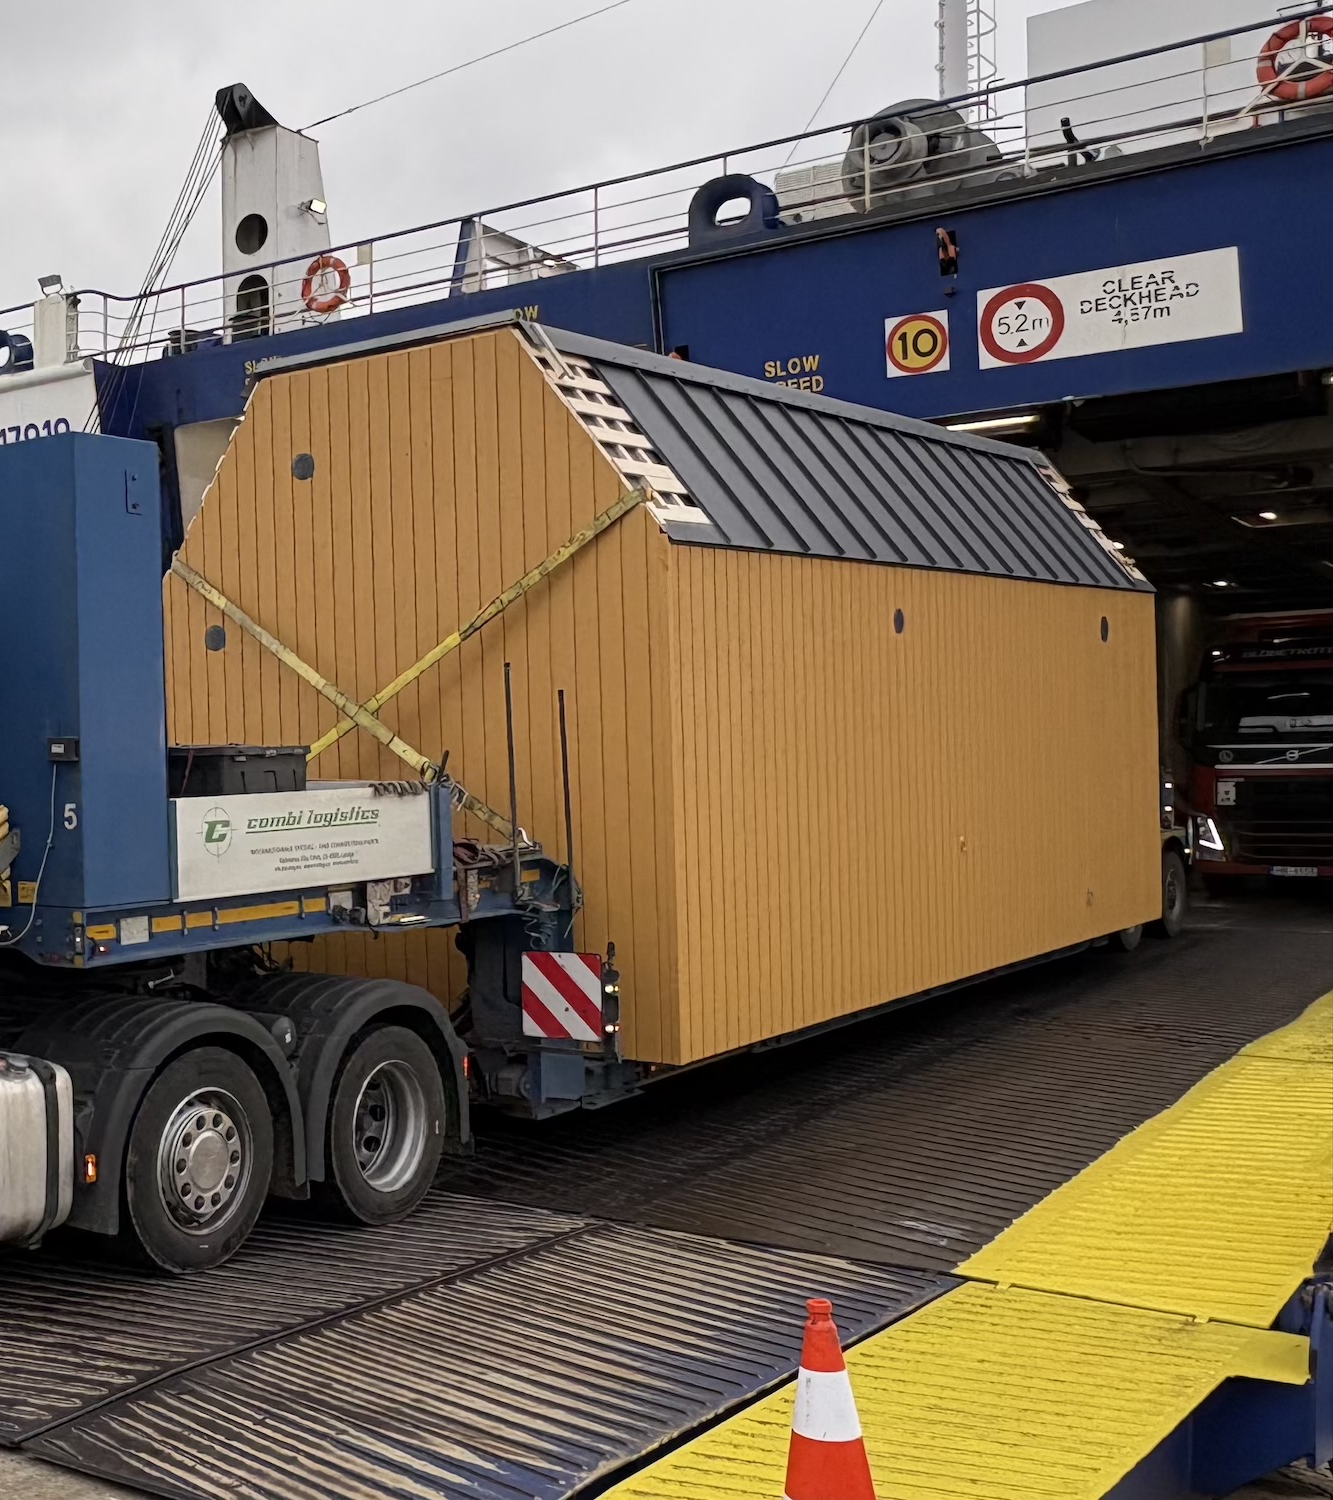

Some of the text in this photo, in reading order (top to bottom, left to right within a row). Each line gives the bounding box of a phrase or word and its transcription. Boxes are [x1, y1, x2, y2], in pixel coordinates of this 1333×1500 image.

[1102, 270, 1175, 294] CLEAR
[1080, 283, 1199, 314] DECKHEAD
[897, 328, 938, 360] 10
[764, 355, 819, 378] SLOW
[64, 803, 78, 830] 5
[246, 806, 380, 830] combi logistics
